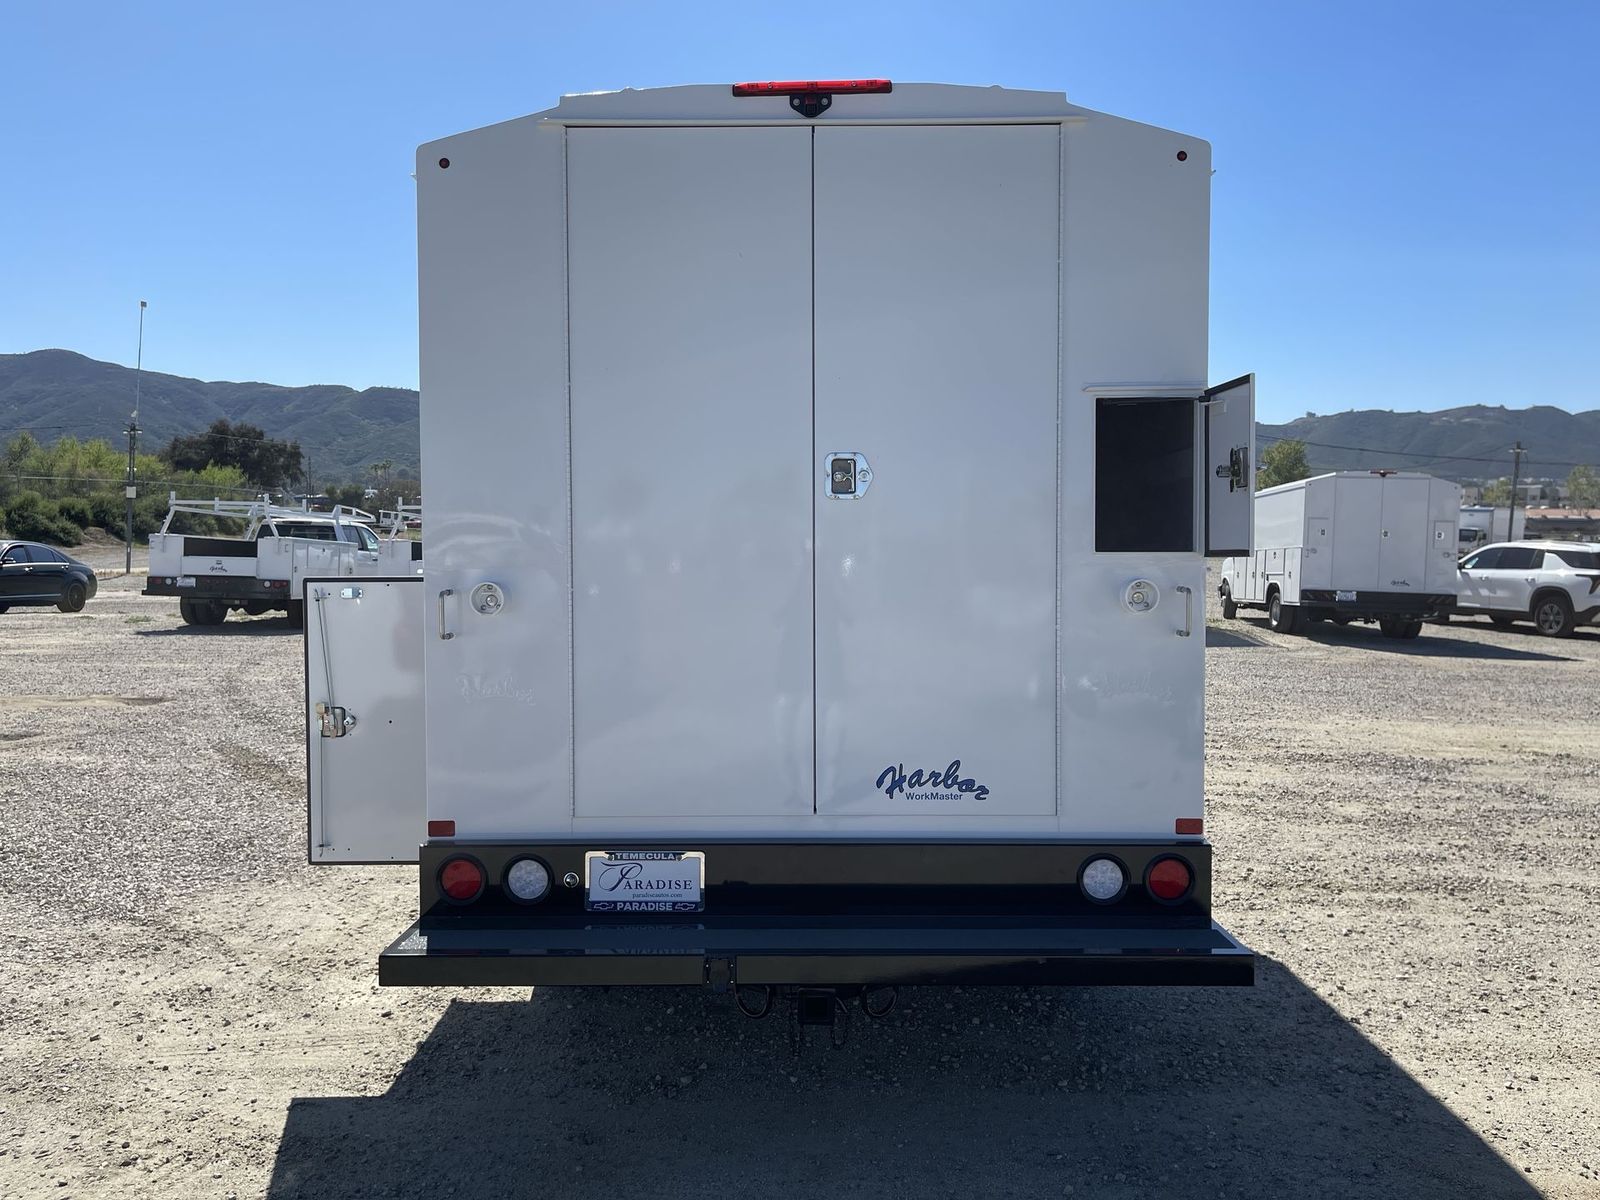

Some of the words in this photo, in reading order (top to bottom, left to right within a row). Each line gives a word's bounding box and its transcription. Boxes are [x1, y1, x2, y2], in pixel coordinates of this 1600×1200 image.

[876, 760, 990, 800] Harbor
[905, 792, 963, 800] WorkMaster
[616, 852, 675, 860] TEMECULA
[617, 902, 673, 911] PARADISE
